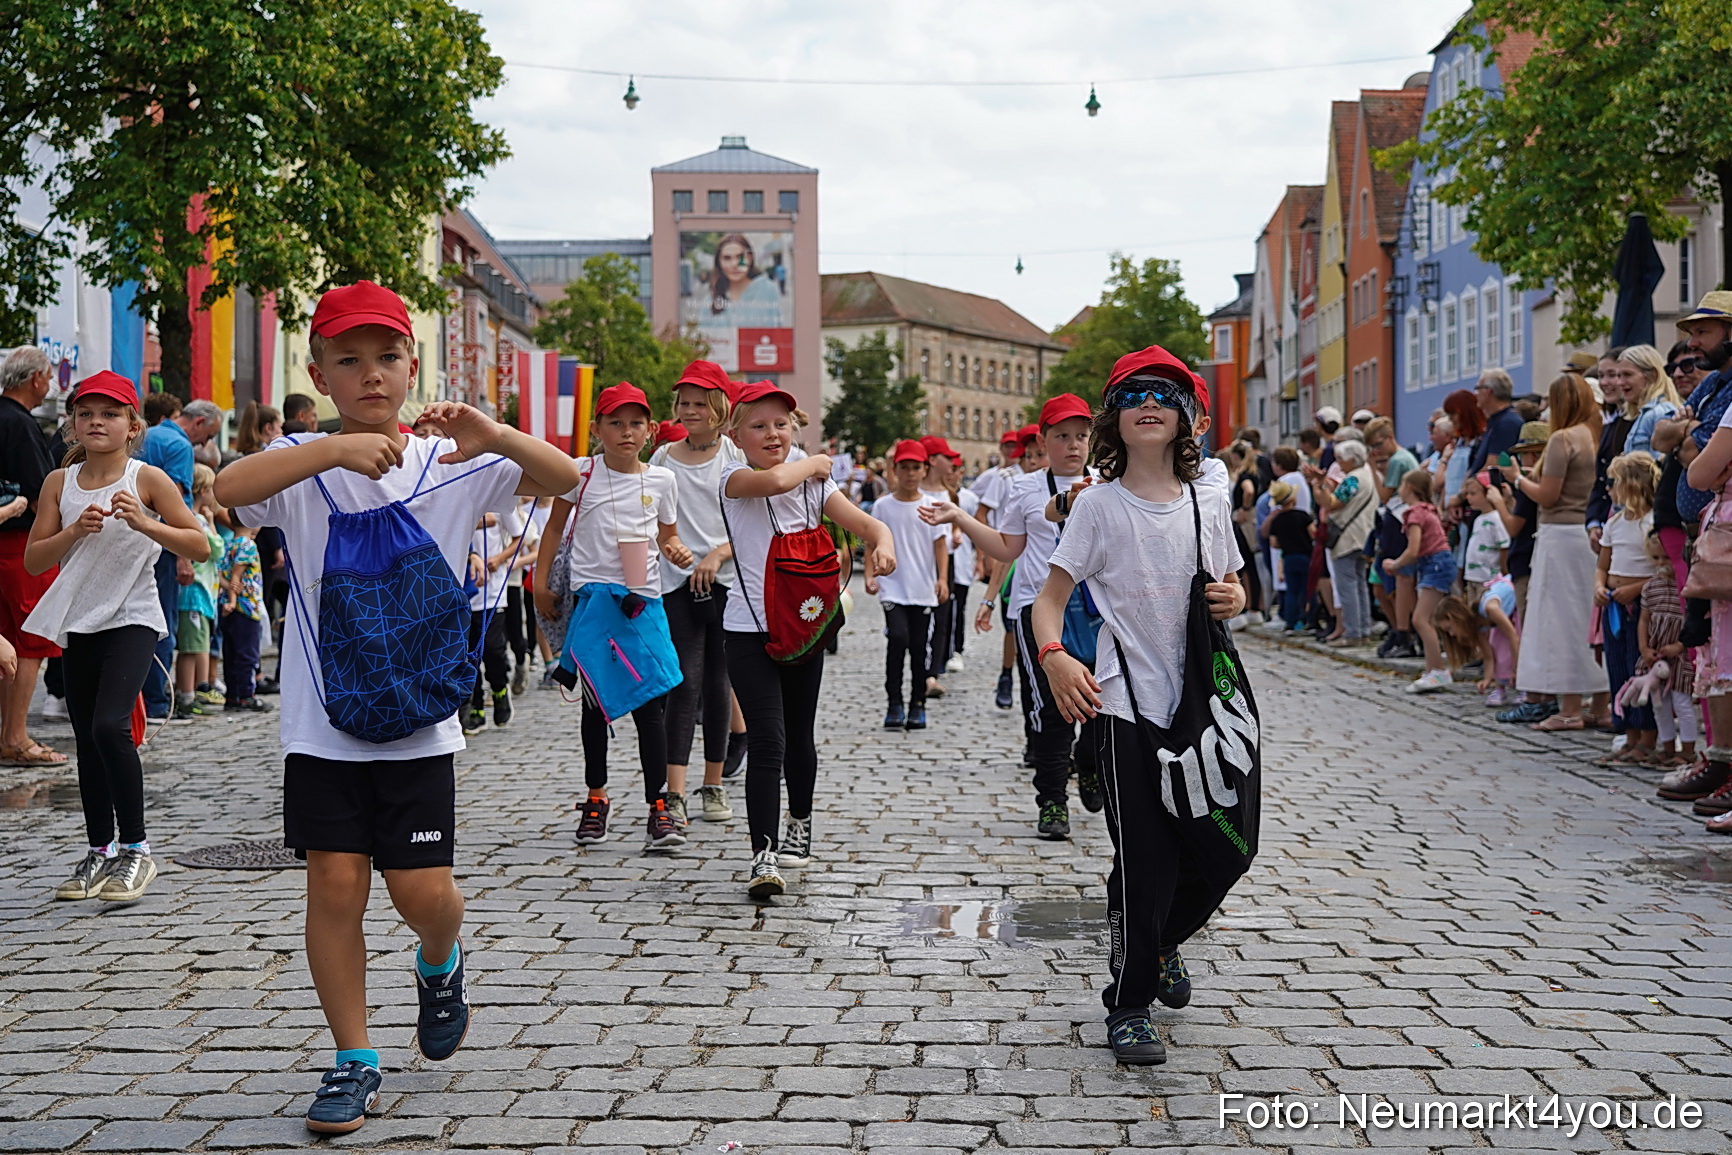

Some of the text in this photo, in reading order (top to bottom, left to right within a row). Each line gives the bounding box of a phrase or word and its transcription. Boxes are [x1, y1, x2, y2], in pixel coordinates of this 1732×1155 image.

[410, 830, 442, 843] JAKO
[1110, 910, 1124, 970] hummel
[436, 989, 453, 999] LICO
